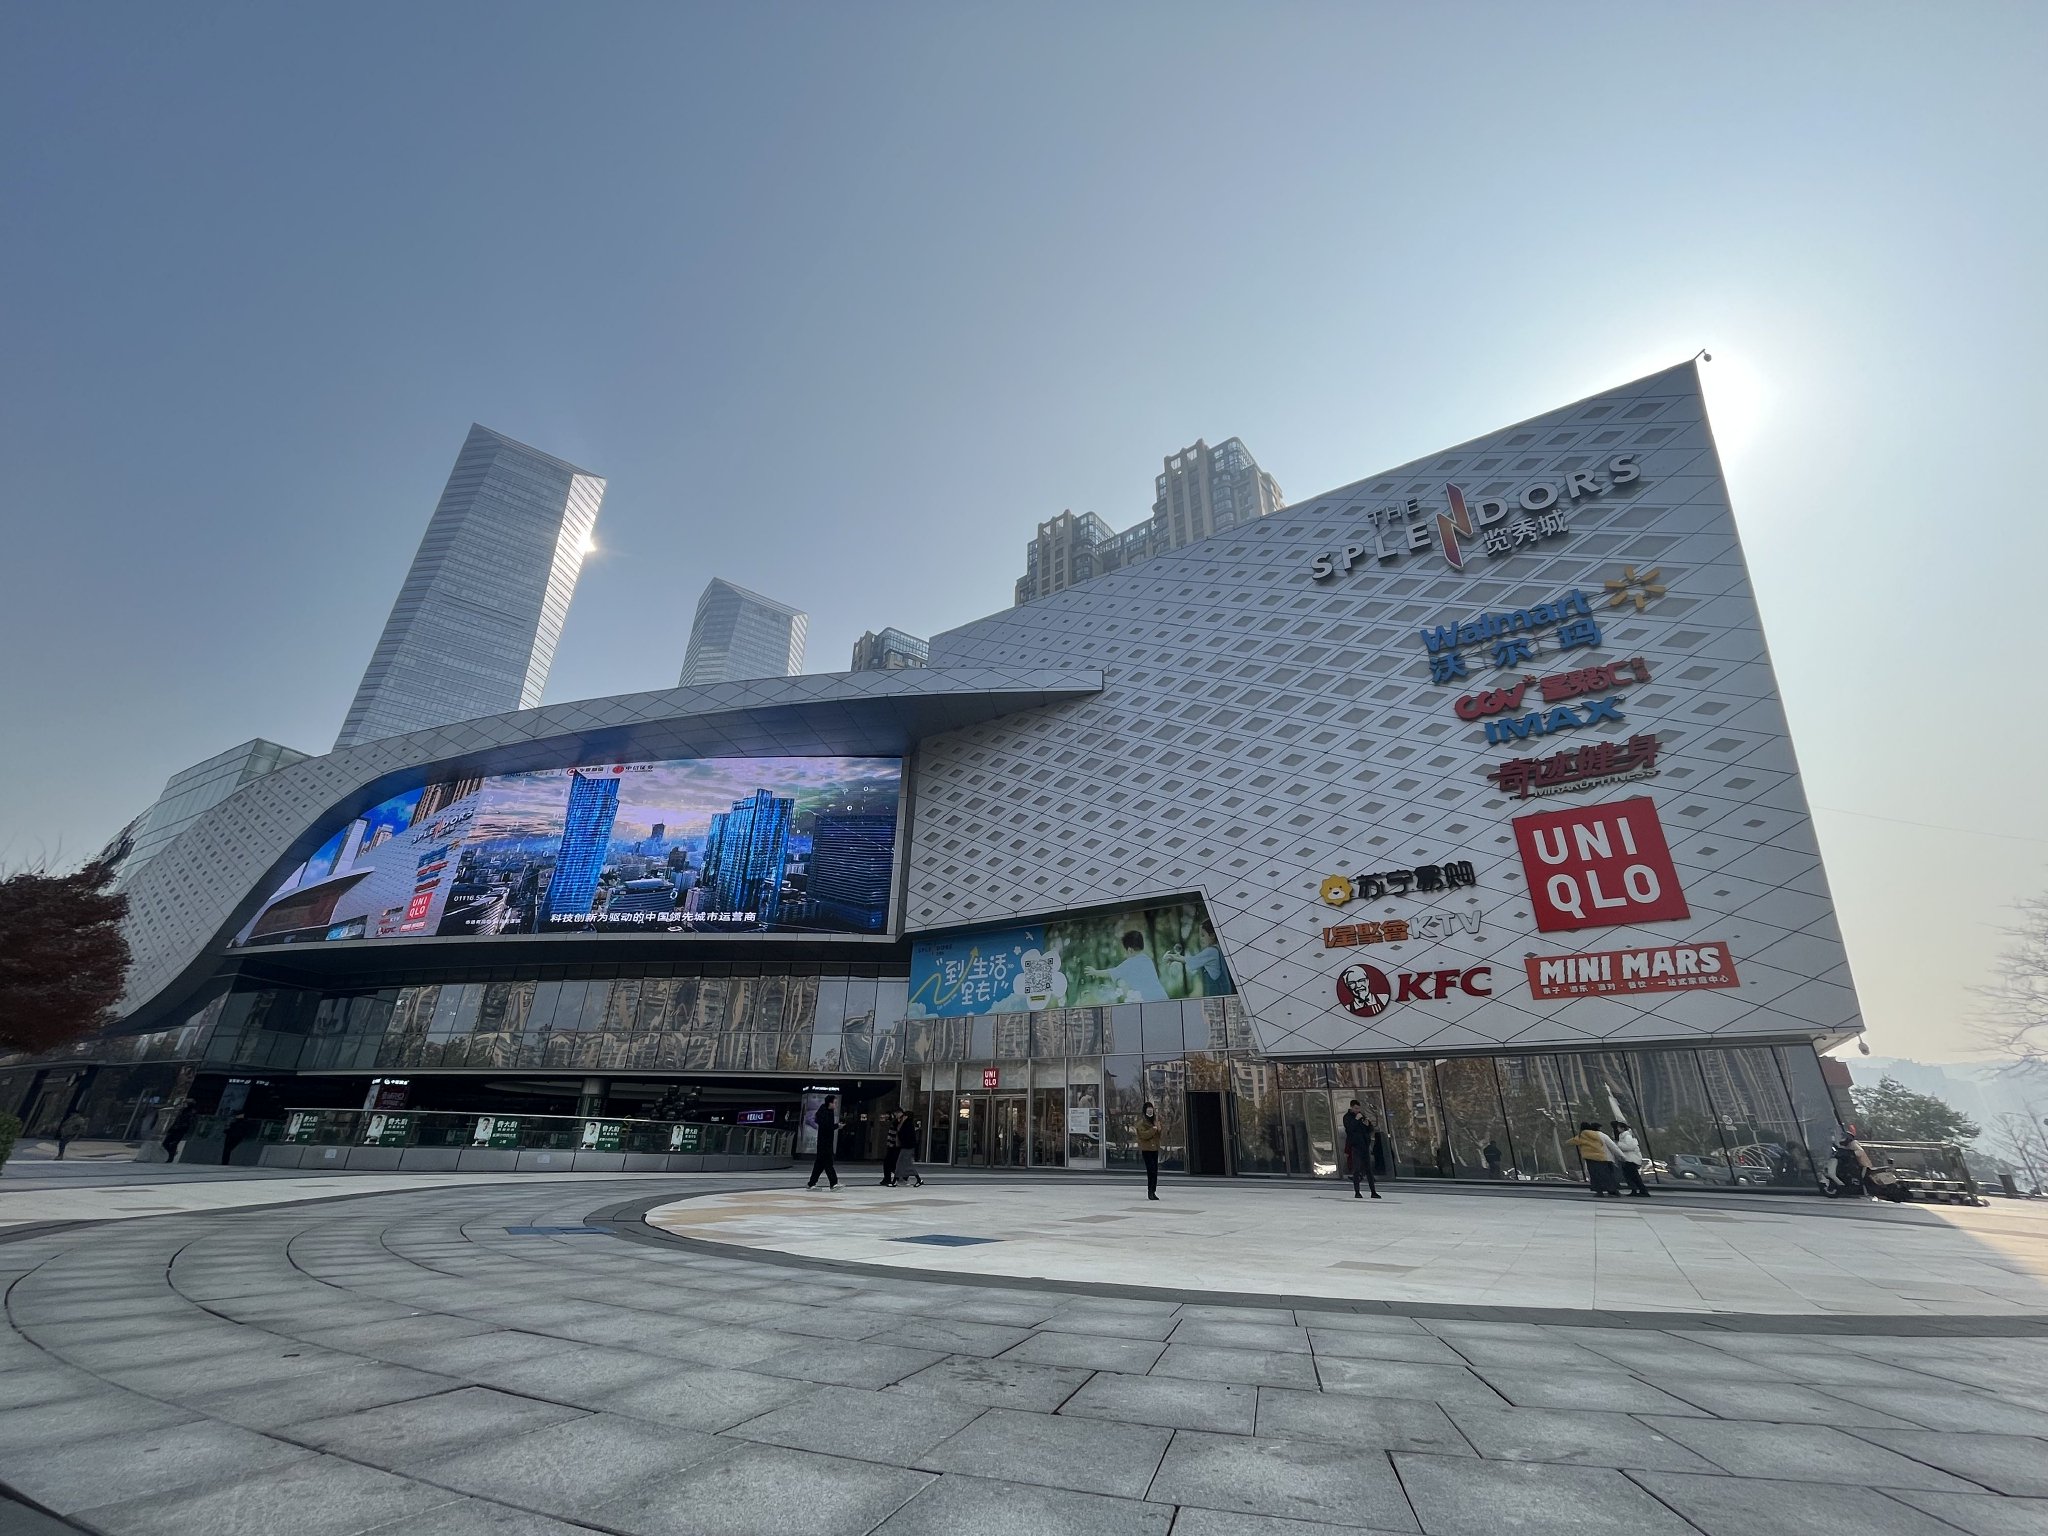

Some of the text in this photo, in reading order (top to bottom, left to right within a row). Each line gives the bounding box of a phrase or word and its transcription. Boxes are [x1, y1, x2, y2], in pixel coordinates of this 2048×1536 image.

[1310, 453, 1641, 582] SPLENDORS
[1367, 497, 1421, 527] THE
[1482, 508, 1570, 557] 览秀城
[1420, 588, 1593, 653] Walmart
[1429, 619, 1602, 685] 沃尔玛
[1454, 682, 1527, 721] CGV
[1484, 697, 1626, 745] IMAX
[1487, 734, 1664, 800] 奇迹健身
[1532, 816, 1638, 866] UNI
[1356, 860, 1476, 901] 苏宁易购
[1547, 864, 1661, 919] QLO
[409, 905, 426, 918] QLO
[412, 896, 428, 907] UNI
[550, 911, 757, 925] 科技创新为驱动的中国领先城市运营商
[1396, 966, 1492, 1002] KFC
[1539, 947, 1722, 986] MINI MARS
[984, 1070, 996, 1078] UNI
[984, 1078, 997, 1087] QLO
